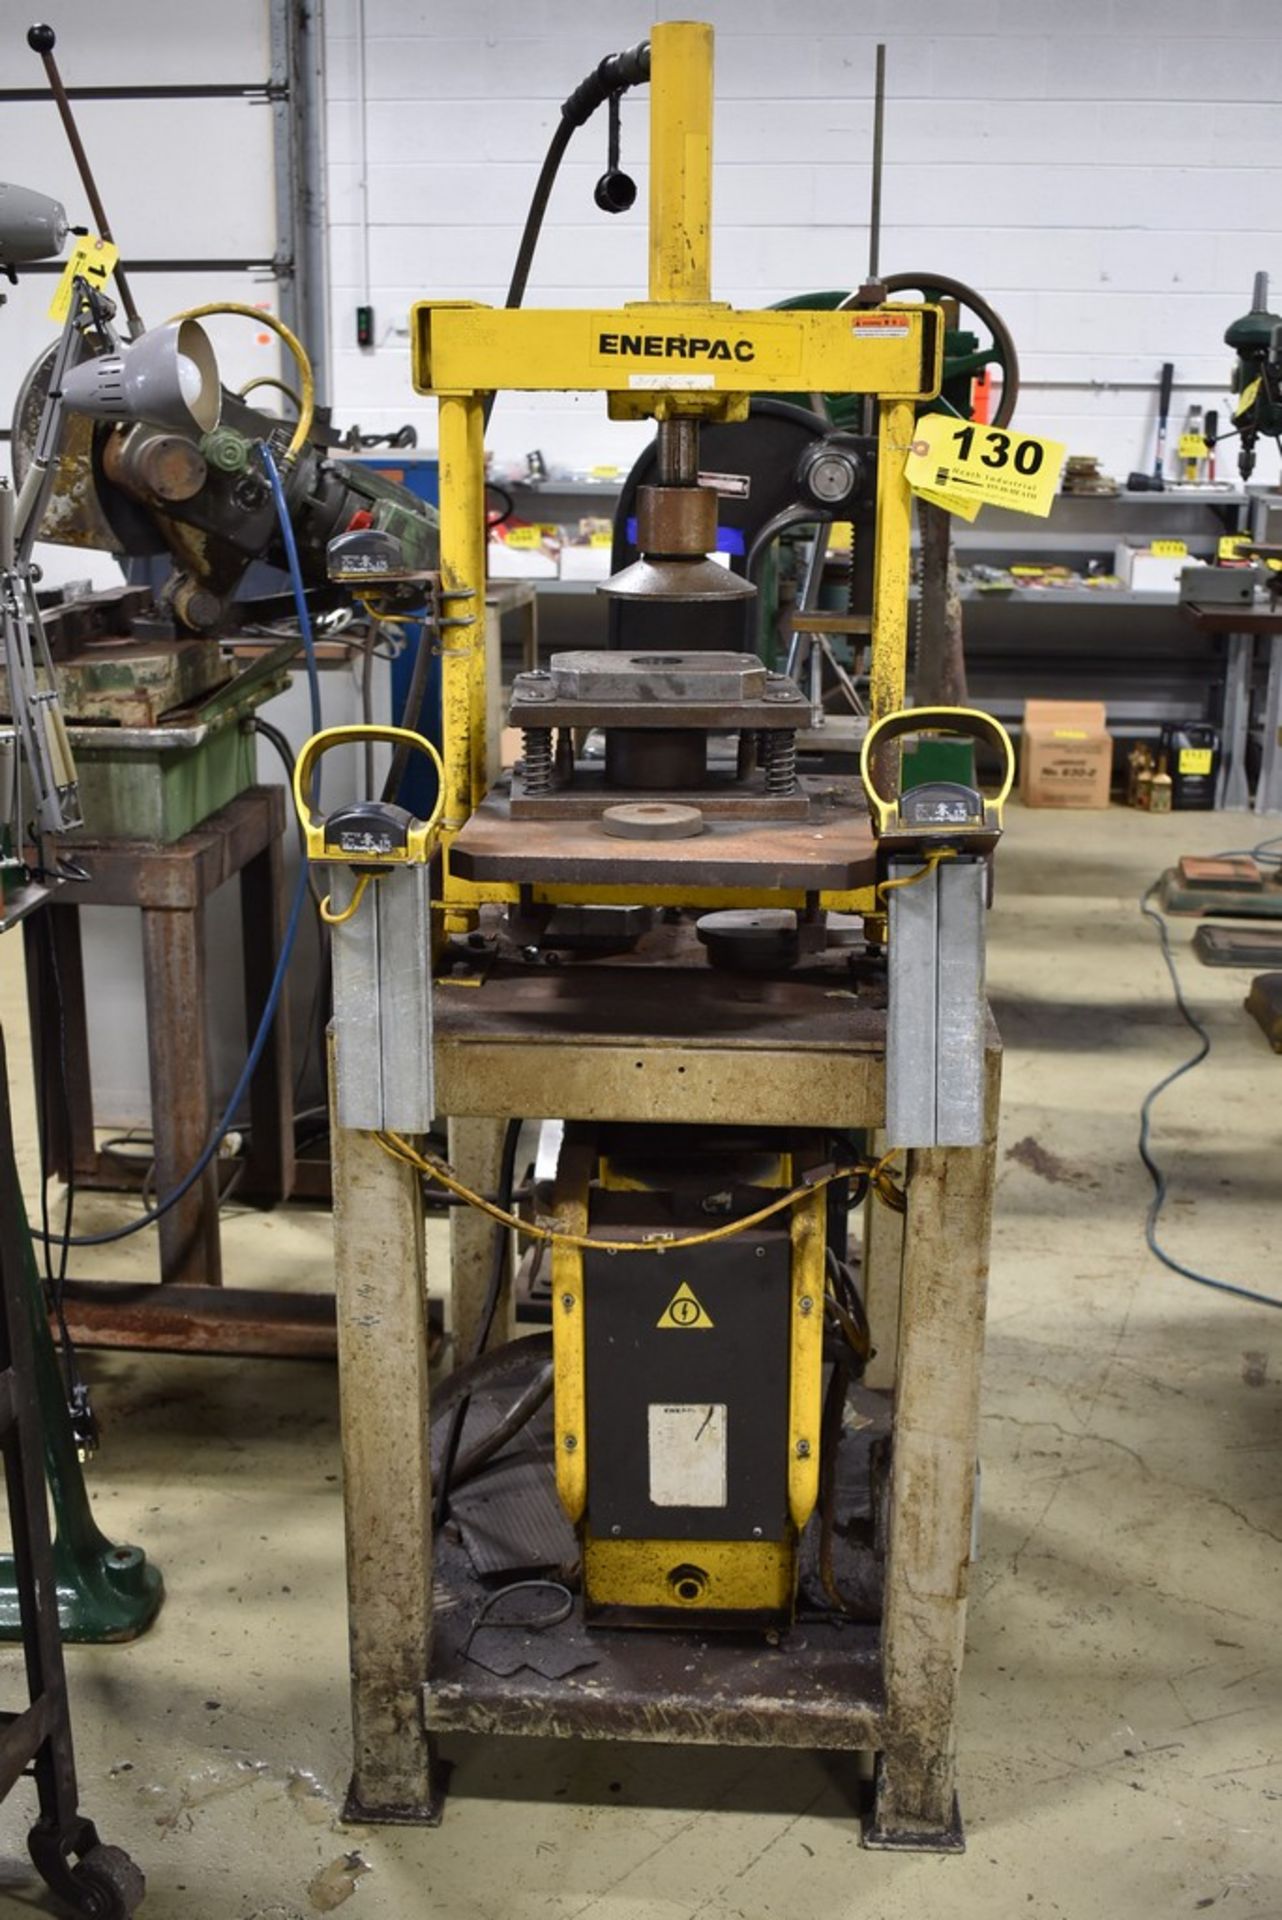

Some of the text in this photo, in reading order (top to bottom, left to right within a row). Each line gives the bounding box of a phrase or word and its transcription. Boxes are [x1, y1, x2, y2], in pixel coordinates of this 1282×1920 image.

[599, 333, 755, 362] ENERPAC
[953, 426, 1044, 475] 130
[952, 467, 1038, 491] Heath Industrial
